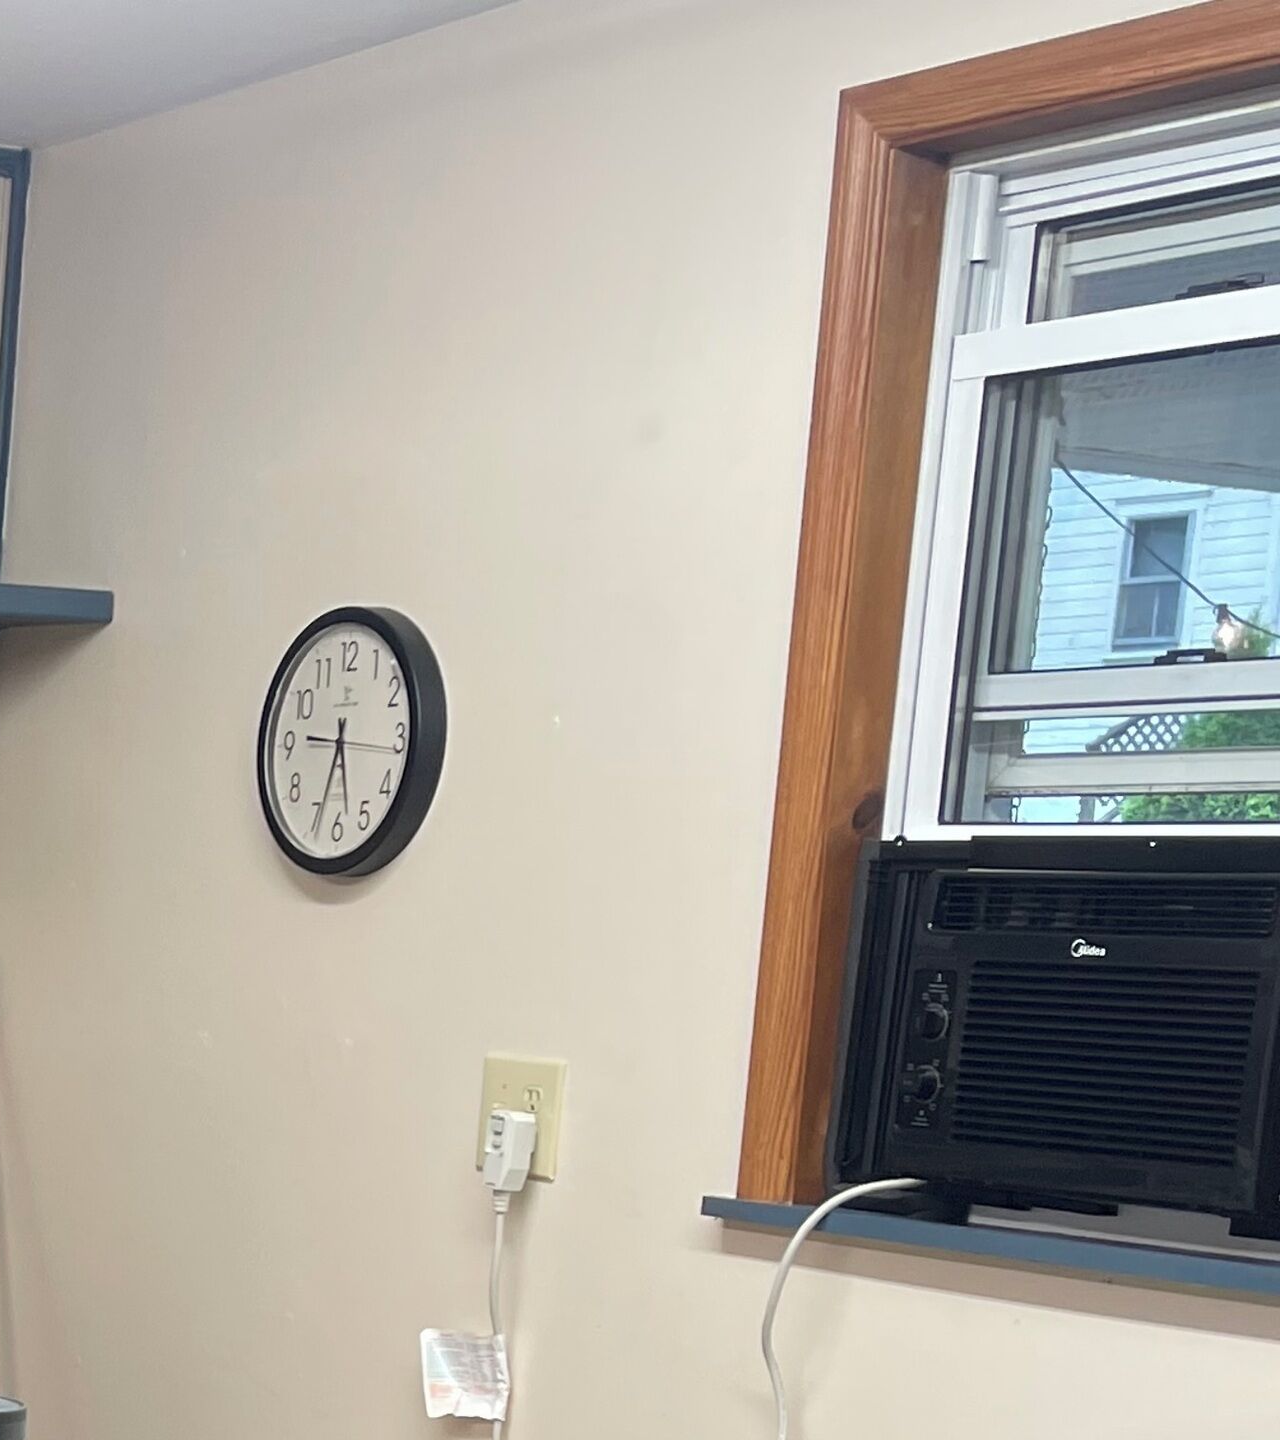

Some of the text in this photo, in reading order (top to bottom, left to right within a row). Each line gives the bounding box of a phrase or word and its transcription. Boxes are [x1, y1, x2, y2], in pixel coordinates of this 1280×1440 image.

[316, 657, 331, 689] 11
[341, 641, 358, 673] 12
[373, 649, 380, 681] 1
[296, 688, 314, 720] 10
[387, 675, 401, 708] 2
[284, 730, 296, 760] 9
[393, 722, 406, 754] 3
[289, 772, 301, 803] 8
[379, 768, 392, 799] 4
[310, 801, 321, 833] 7
[331, 811, 343, 842] 6
[357, 800, 370, 831] 5
